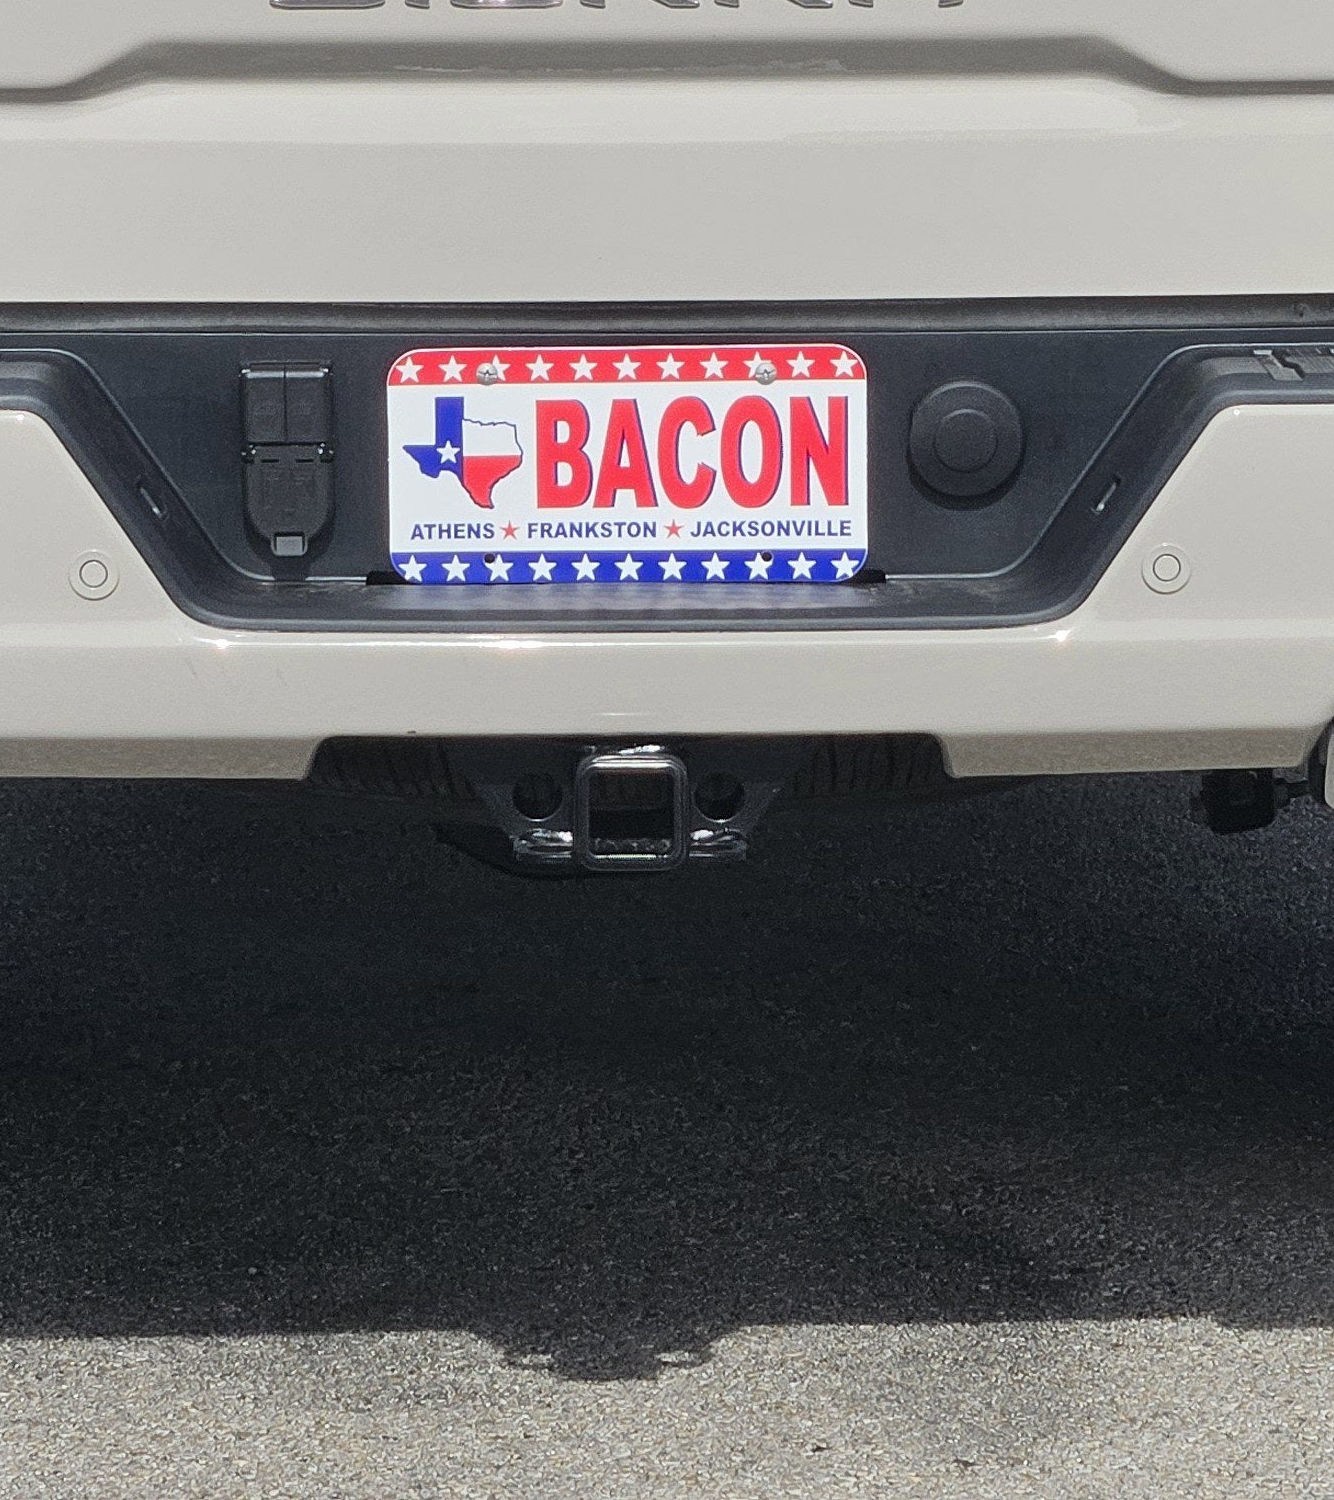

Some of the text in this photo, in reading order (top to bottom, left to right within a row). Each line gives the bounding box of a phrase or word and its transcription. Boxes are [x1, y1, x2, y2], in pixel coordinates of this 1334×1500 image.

[535, 395, 850, 509] BACON
[410, 519, 852, 540] ATHENS FRANKSTON JACKSONVILLE
